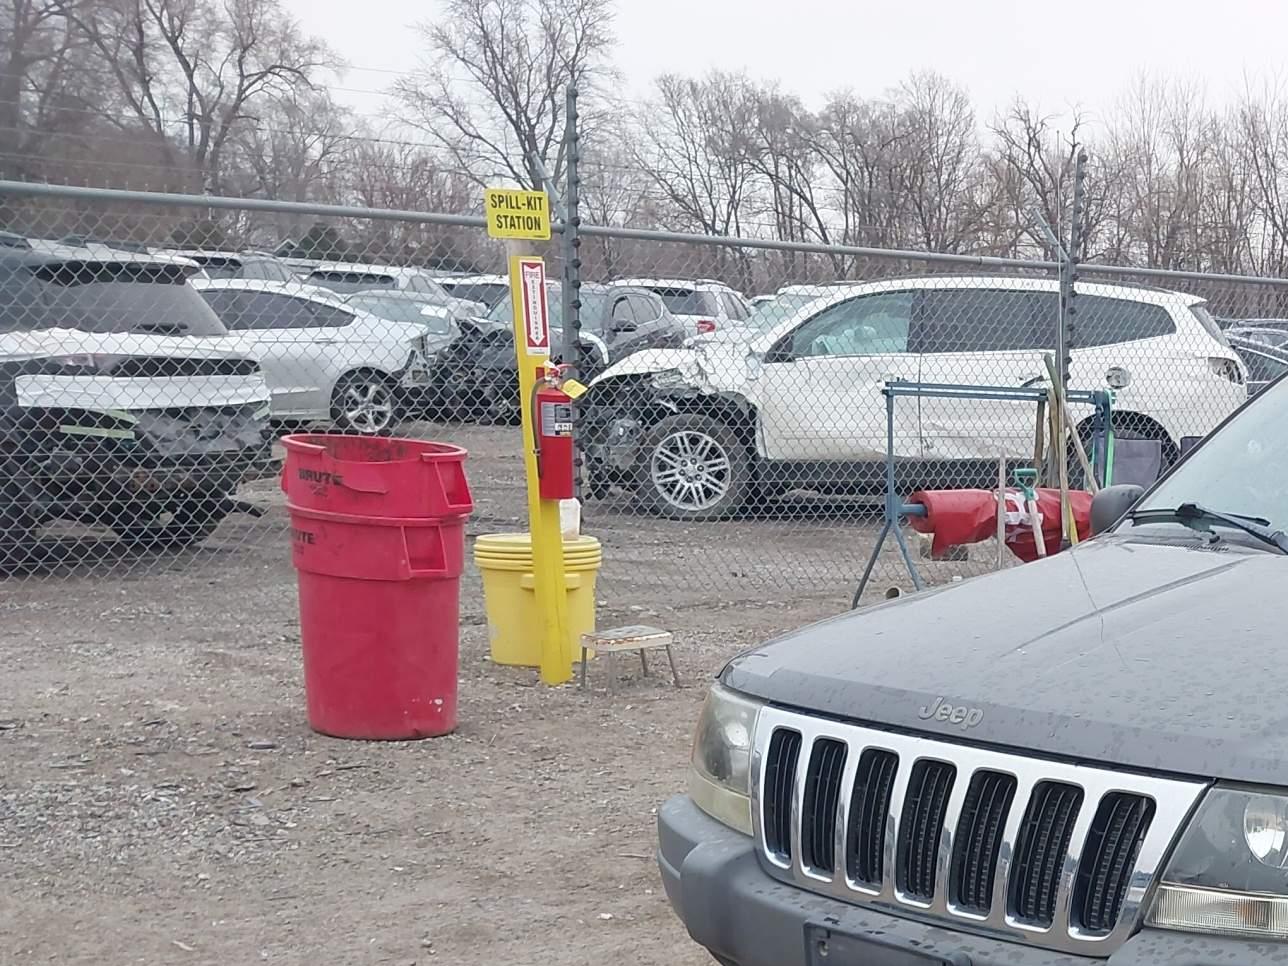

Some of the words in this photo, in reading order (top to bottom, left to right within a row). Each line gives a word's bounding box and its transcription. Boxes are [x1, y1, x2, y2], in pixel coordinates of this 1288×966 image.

[491, 193, 544, 211] SPILL-KIT
[496, 214, 542, 231] STATION
[299, 468, 344, 486] BRUTE
[919, 696, 984, 731] Jeep
